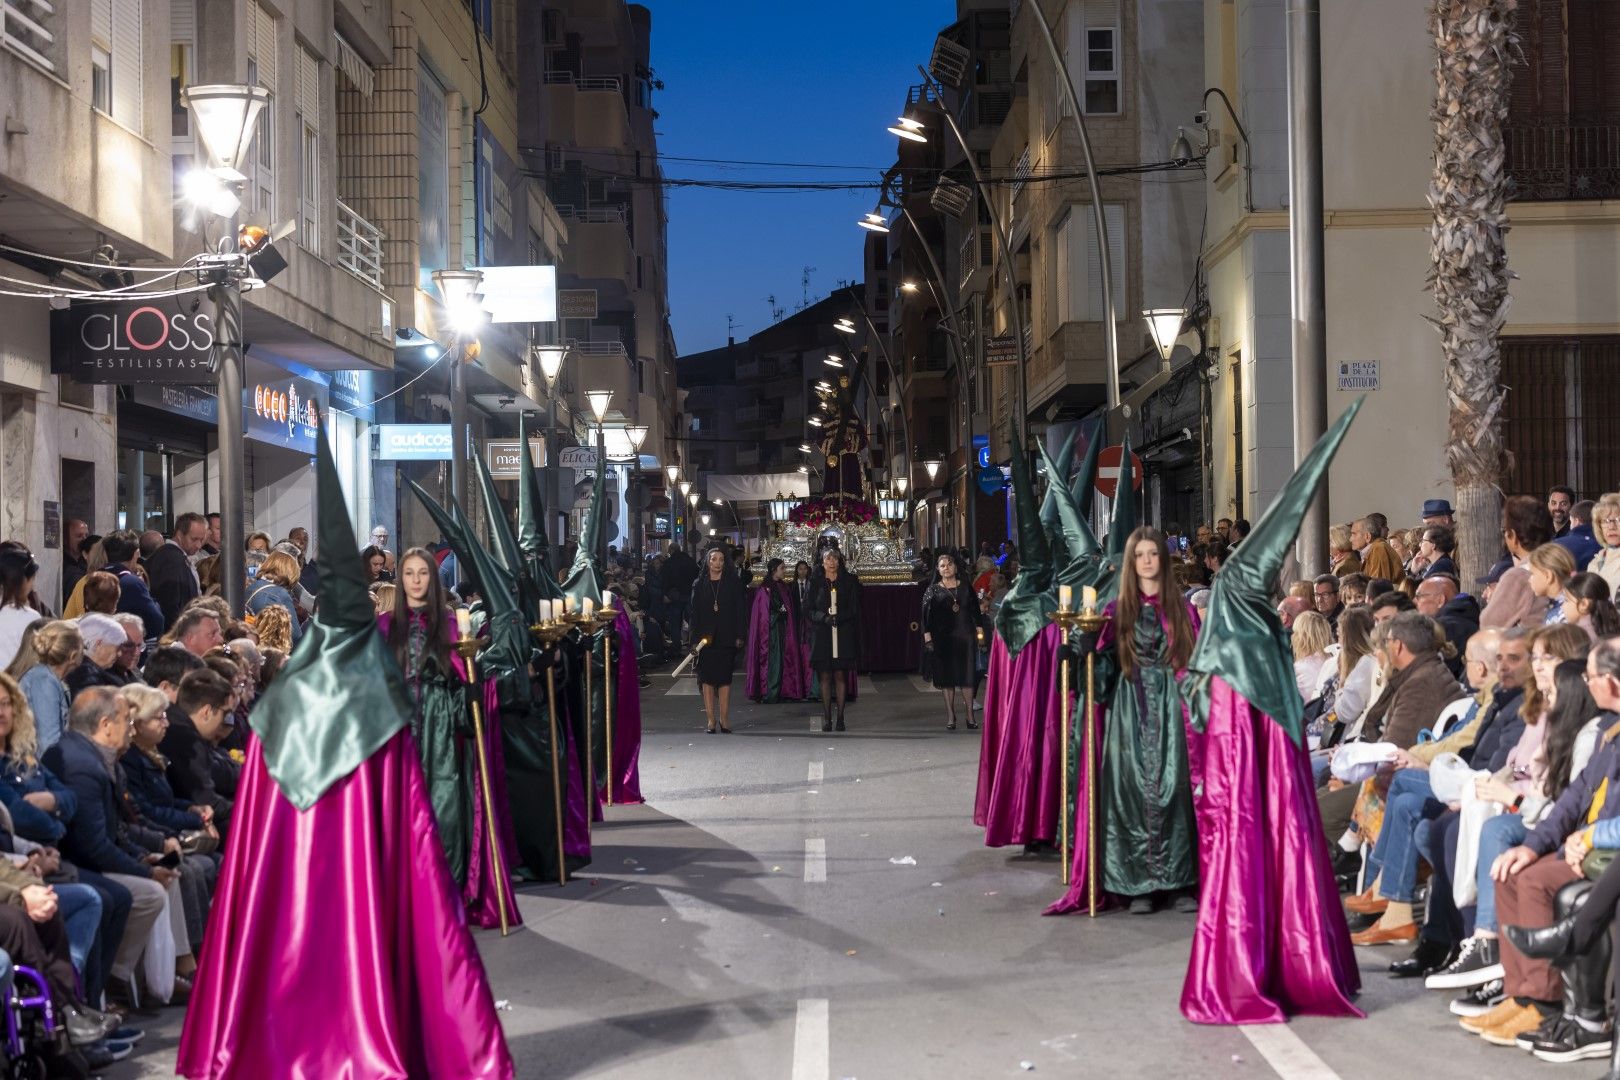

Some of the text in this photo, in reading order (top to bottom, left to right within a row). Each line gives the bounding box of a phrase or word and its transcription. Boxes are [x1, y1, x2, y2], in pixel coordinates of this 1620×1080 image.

[81, 306, 213, 351] GLOSS
[97, 358, 196, 368] ESTILISTAS
[391, 432, 453, 447] audicos
[496, 455, 521, 465] mae
[562, 453, 598, 463] ELICAS
